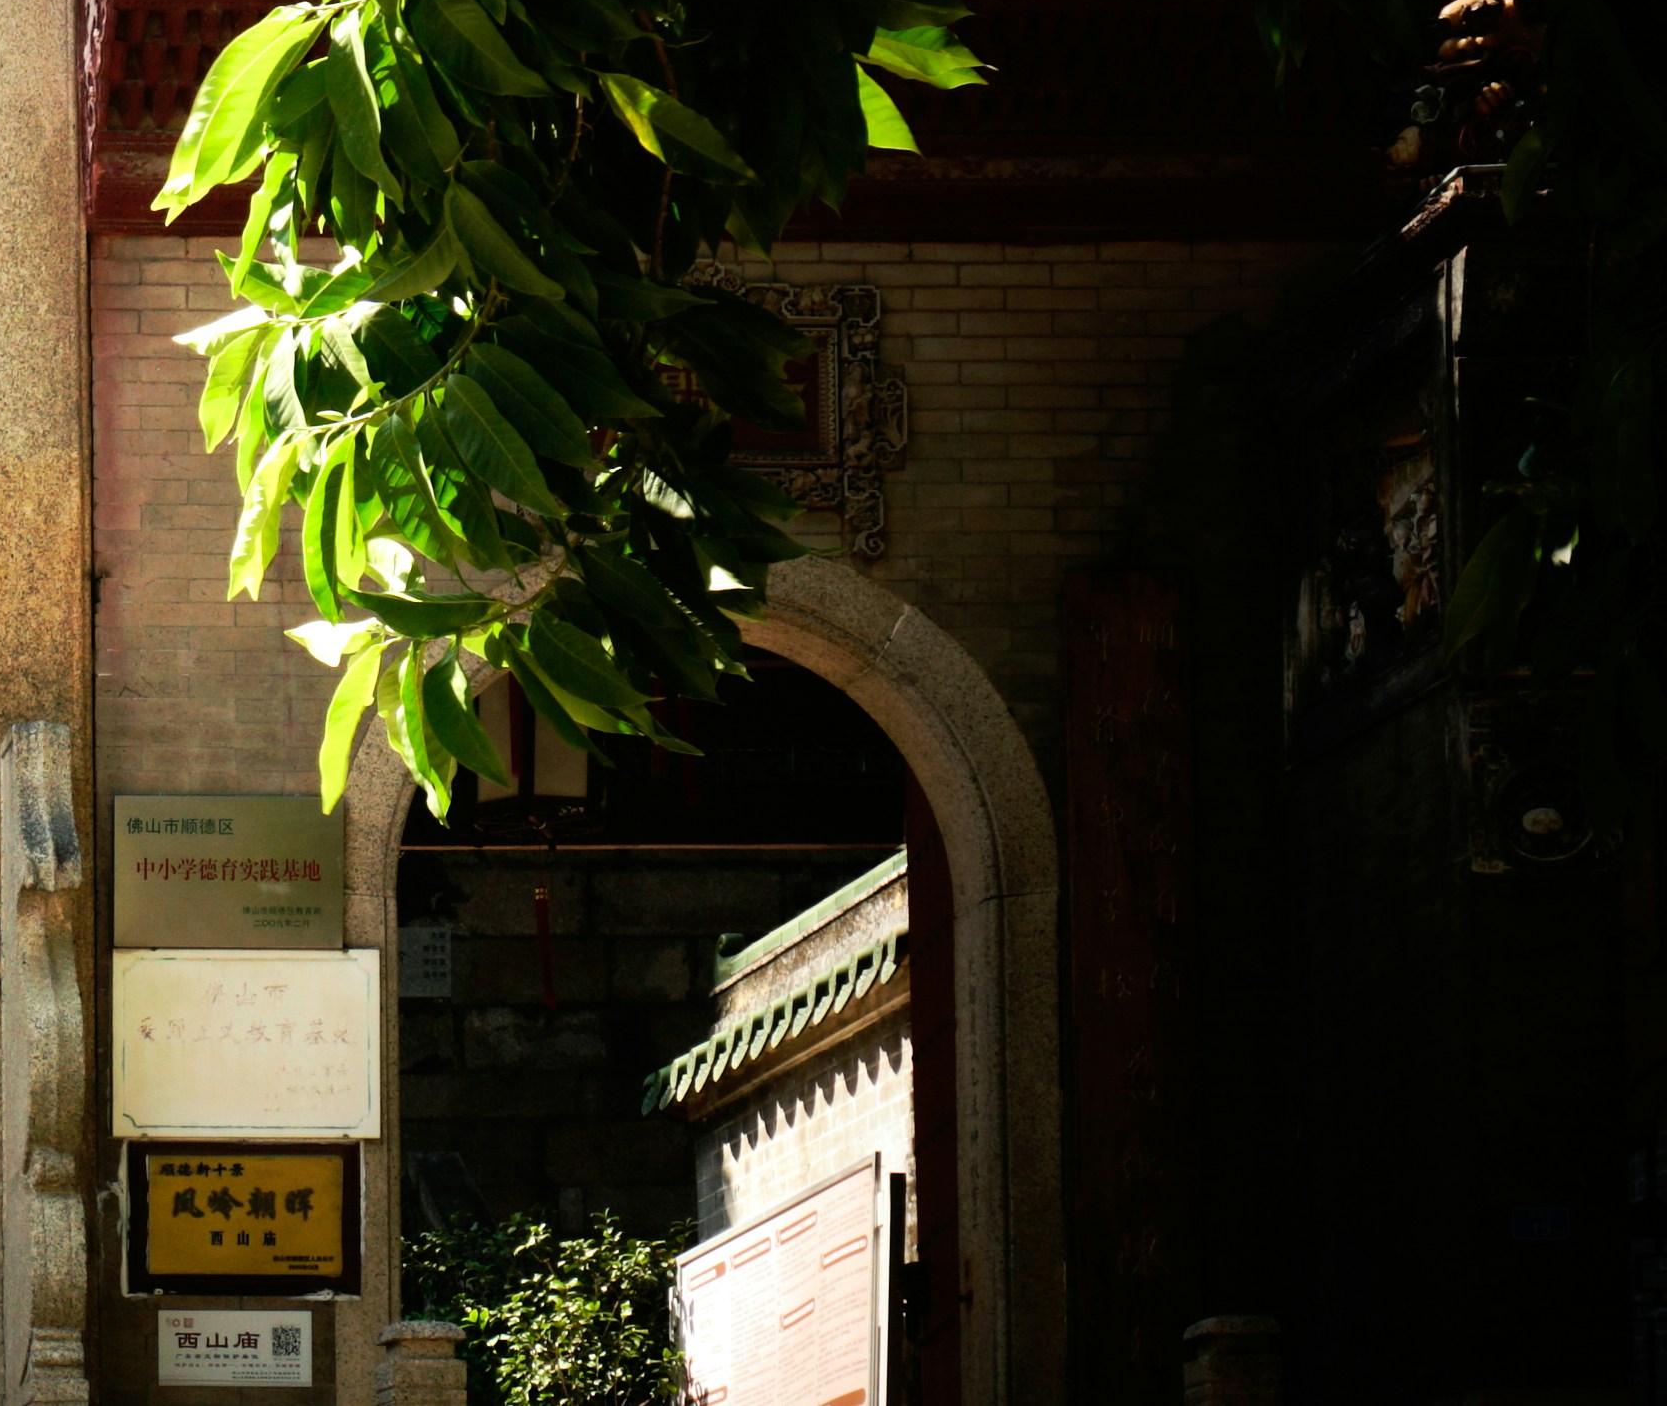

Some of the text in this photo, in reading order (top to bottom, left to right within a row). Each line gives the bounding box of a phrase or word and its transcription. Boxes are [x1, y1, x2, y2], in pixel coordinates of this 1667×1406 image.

[126, 817, 234, 836] 佛山市顺德区
[136, 857, 322, 882] 中小学德育实践基地
[210, 1230, 277, 1246] 西山庙
[174, 1332, 261, 1350] 西山庙
